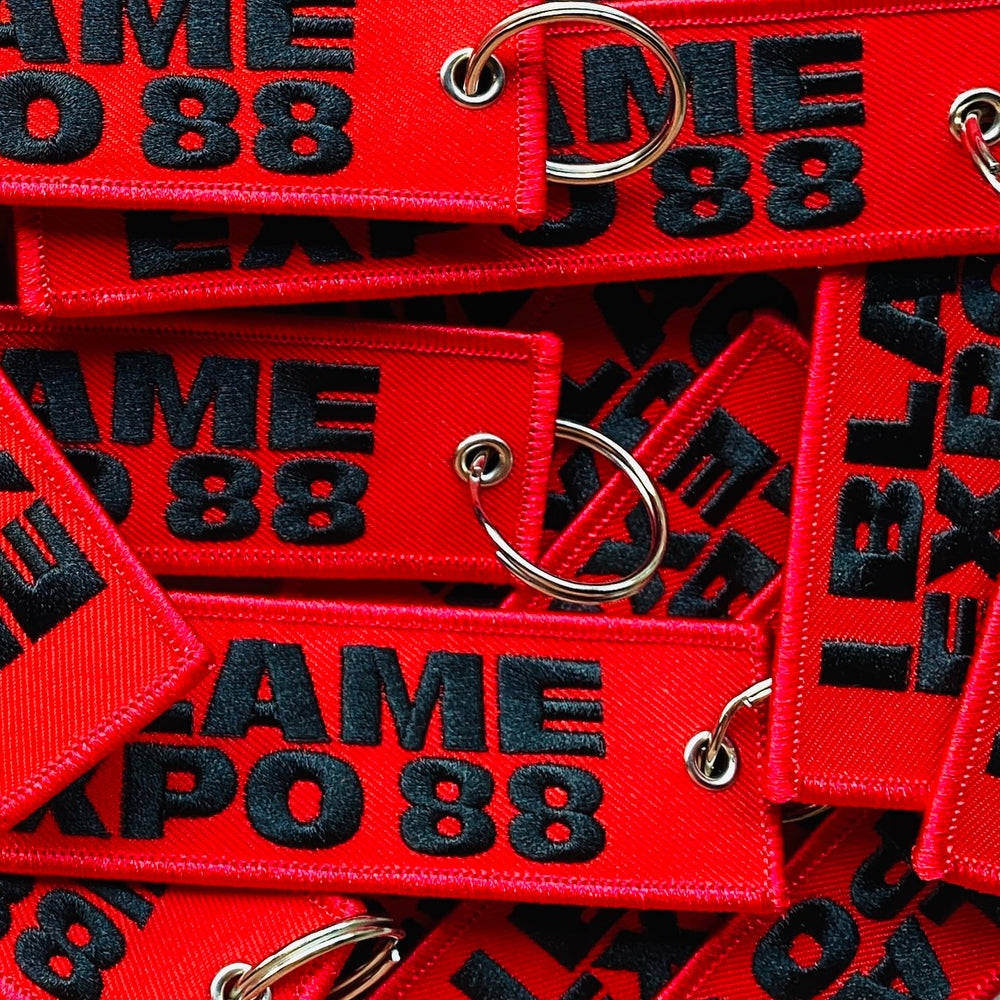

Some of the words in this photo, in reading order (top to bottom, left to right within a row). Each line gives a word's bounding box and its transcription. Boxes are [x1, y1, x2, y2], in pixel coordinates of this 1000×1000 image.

[140, 76, 356, 175] 88
[651, 136, 867, 239] 88
[0, 346, 381, 453] AME
[828, 256, 966, 602] BLA
[164, 453, 368, 543] 88
[140, 638, 606, 758] AME
[818, 640, 912, 690] I
[400, 757, 606, 863] 88
